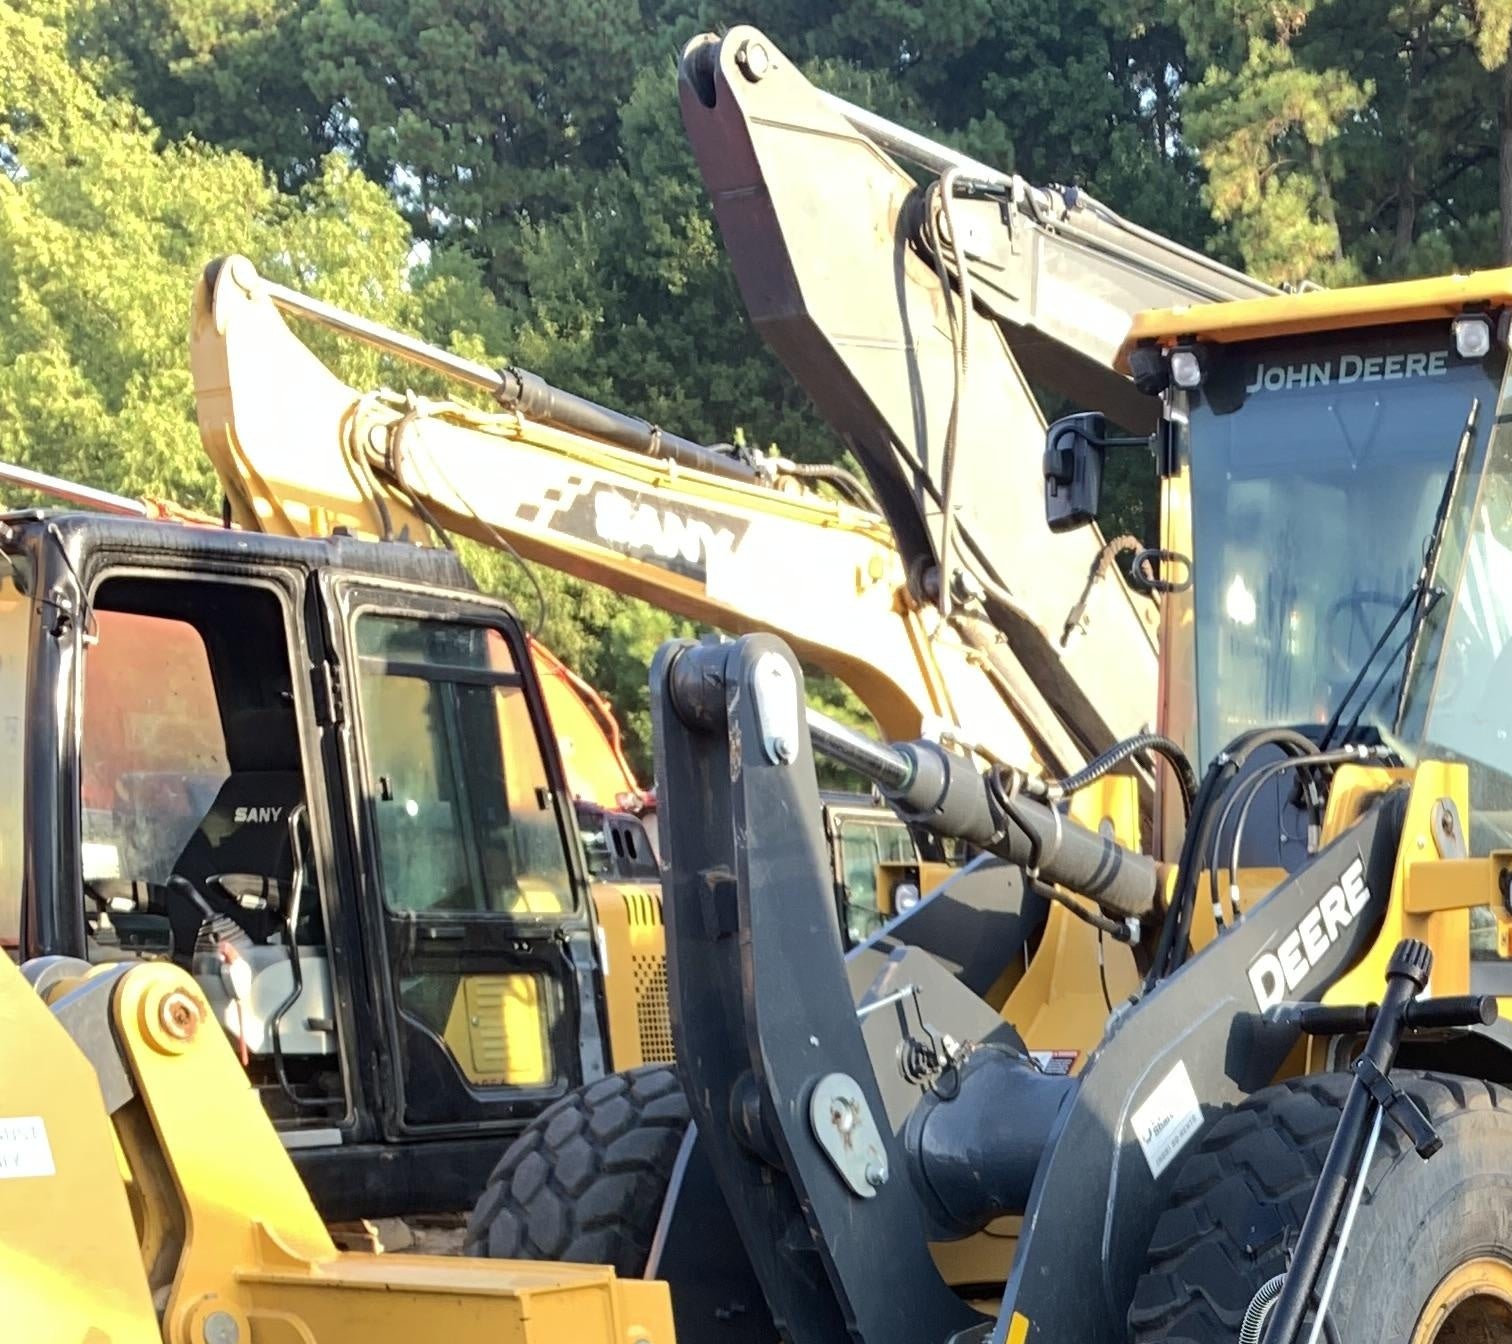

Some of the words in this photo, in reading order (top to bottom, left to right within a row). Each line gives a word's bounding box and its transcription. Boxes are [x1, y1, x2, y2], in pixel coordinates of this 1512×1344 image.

[1246, 361, 1331, 394] JOHN
[1338, 350, 1449, 384] DEERE
[594, 489, 735, 568] SANY
[233, 806, 283, 823] SANY
[1247, 857, 1371, 1015] DEERE
